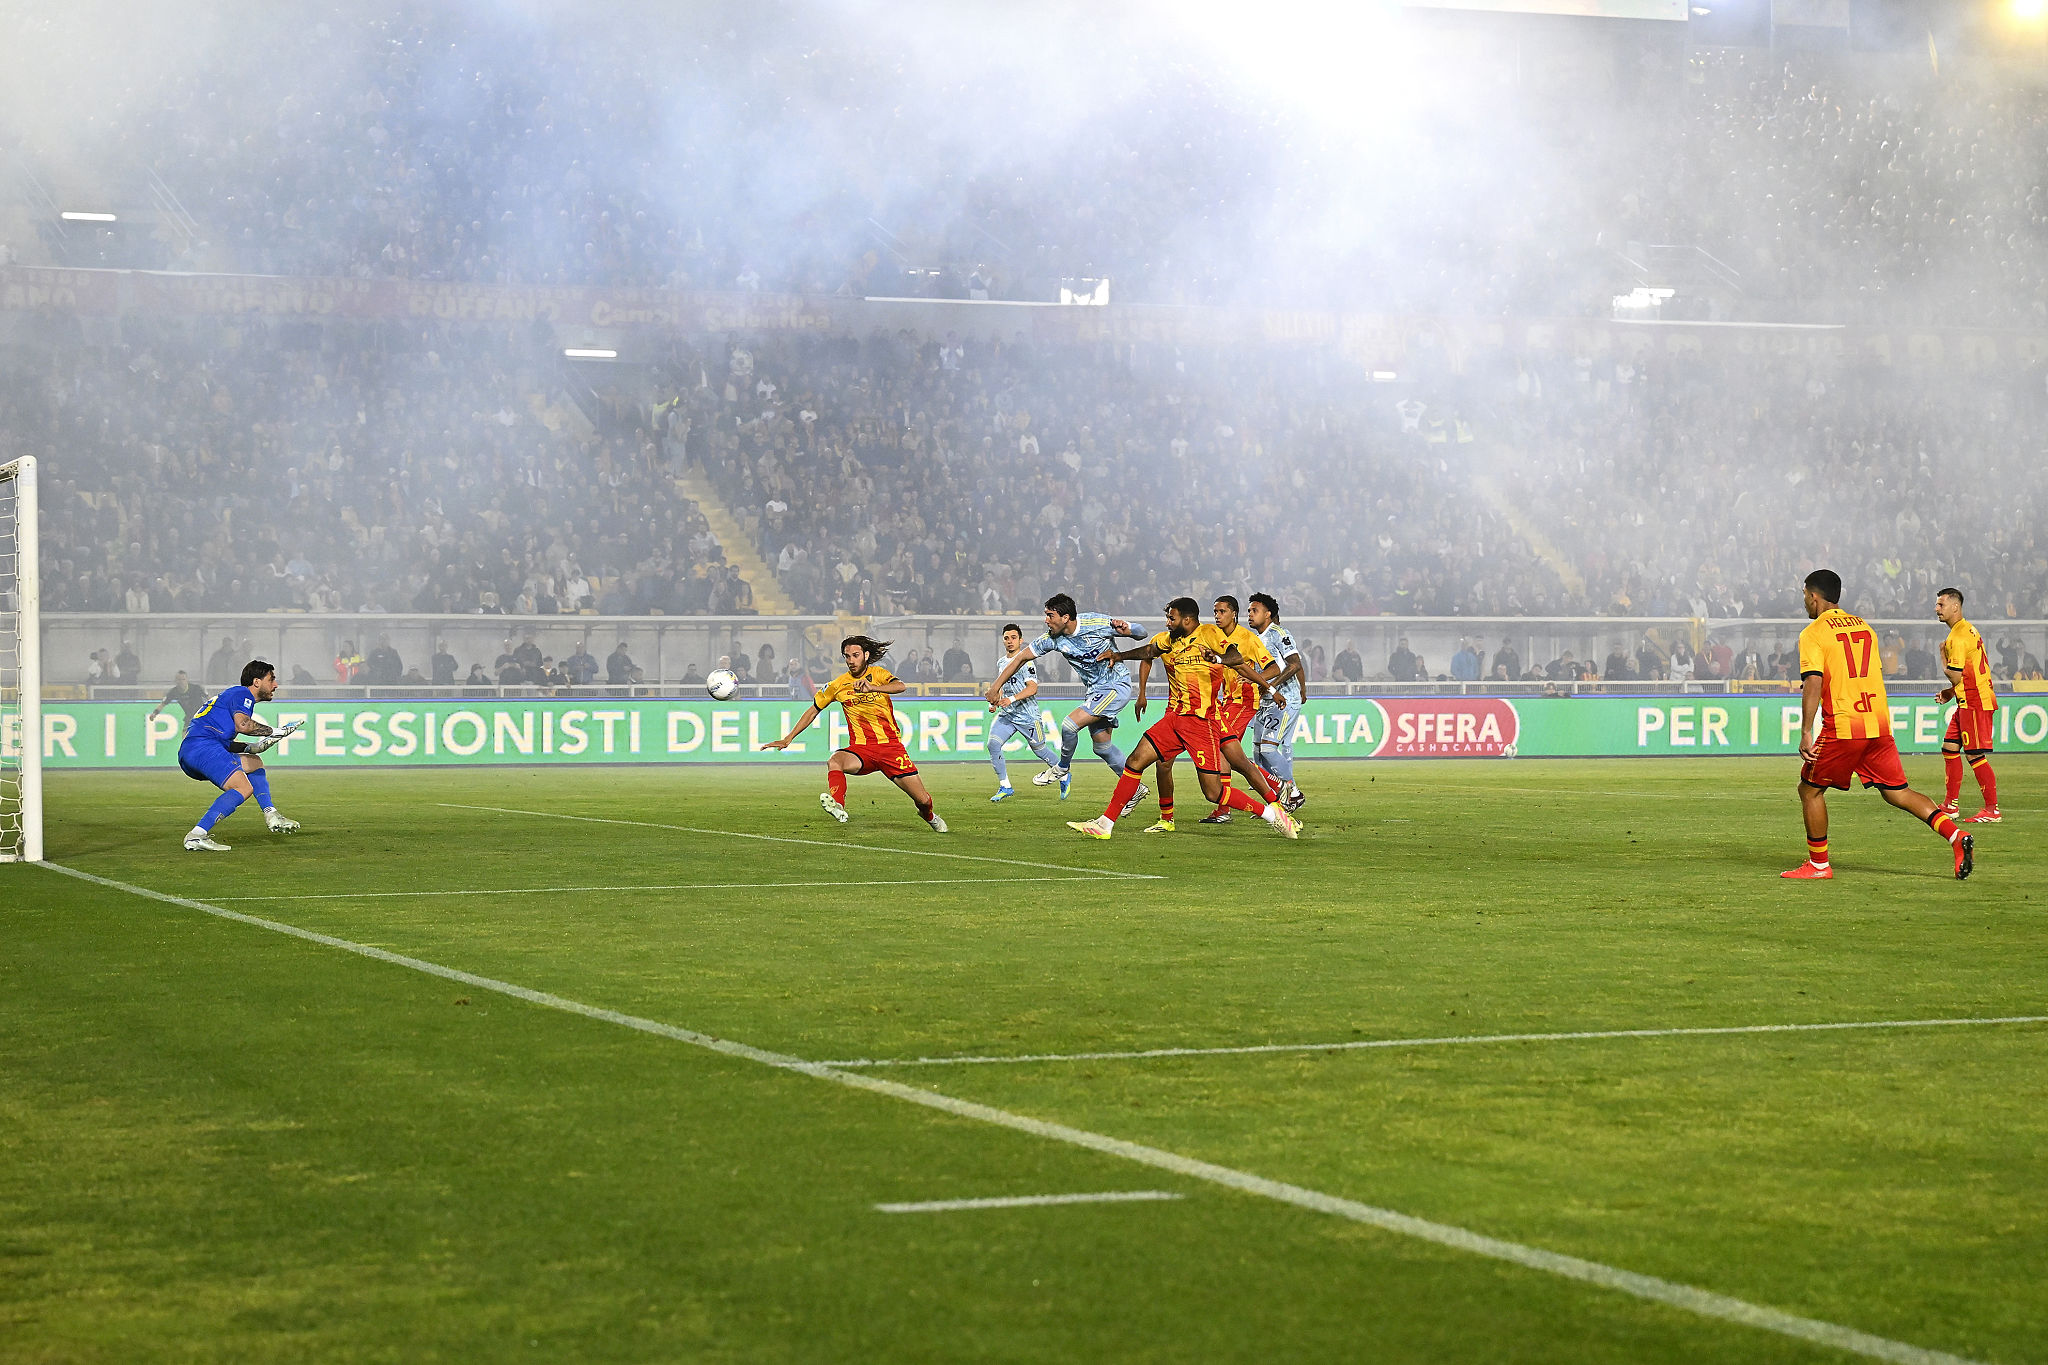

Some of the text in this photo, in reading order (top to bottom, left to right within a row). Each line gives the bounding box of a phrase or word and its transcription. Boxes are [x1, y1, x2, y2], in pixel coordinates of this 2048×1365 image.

[1825, 616, 1865, 629] HELENA
[1835, 630, 1872, 679] 17
[1263, 715, 1280, 731] 22
[1291, 712, 1504, 745] ALTA SFERA
[1637, 705, 1730, 747] PER
[1749, 706, 1760, 746] I
[2, 713, 78, 757] ER
[105, 713, 116, 757] I
[145, 710, 640, 757] PFESSIONISTI
[1028, 727, 1035, 738] 7
[1961, 731, 1970, 746] 0
[895, 753, 913, 770] 25
[1196, 750, 1206, 767] 5
